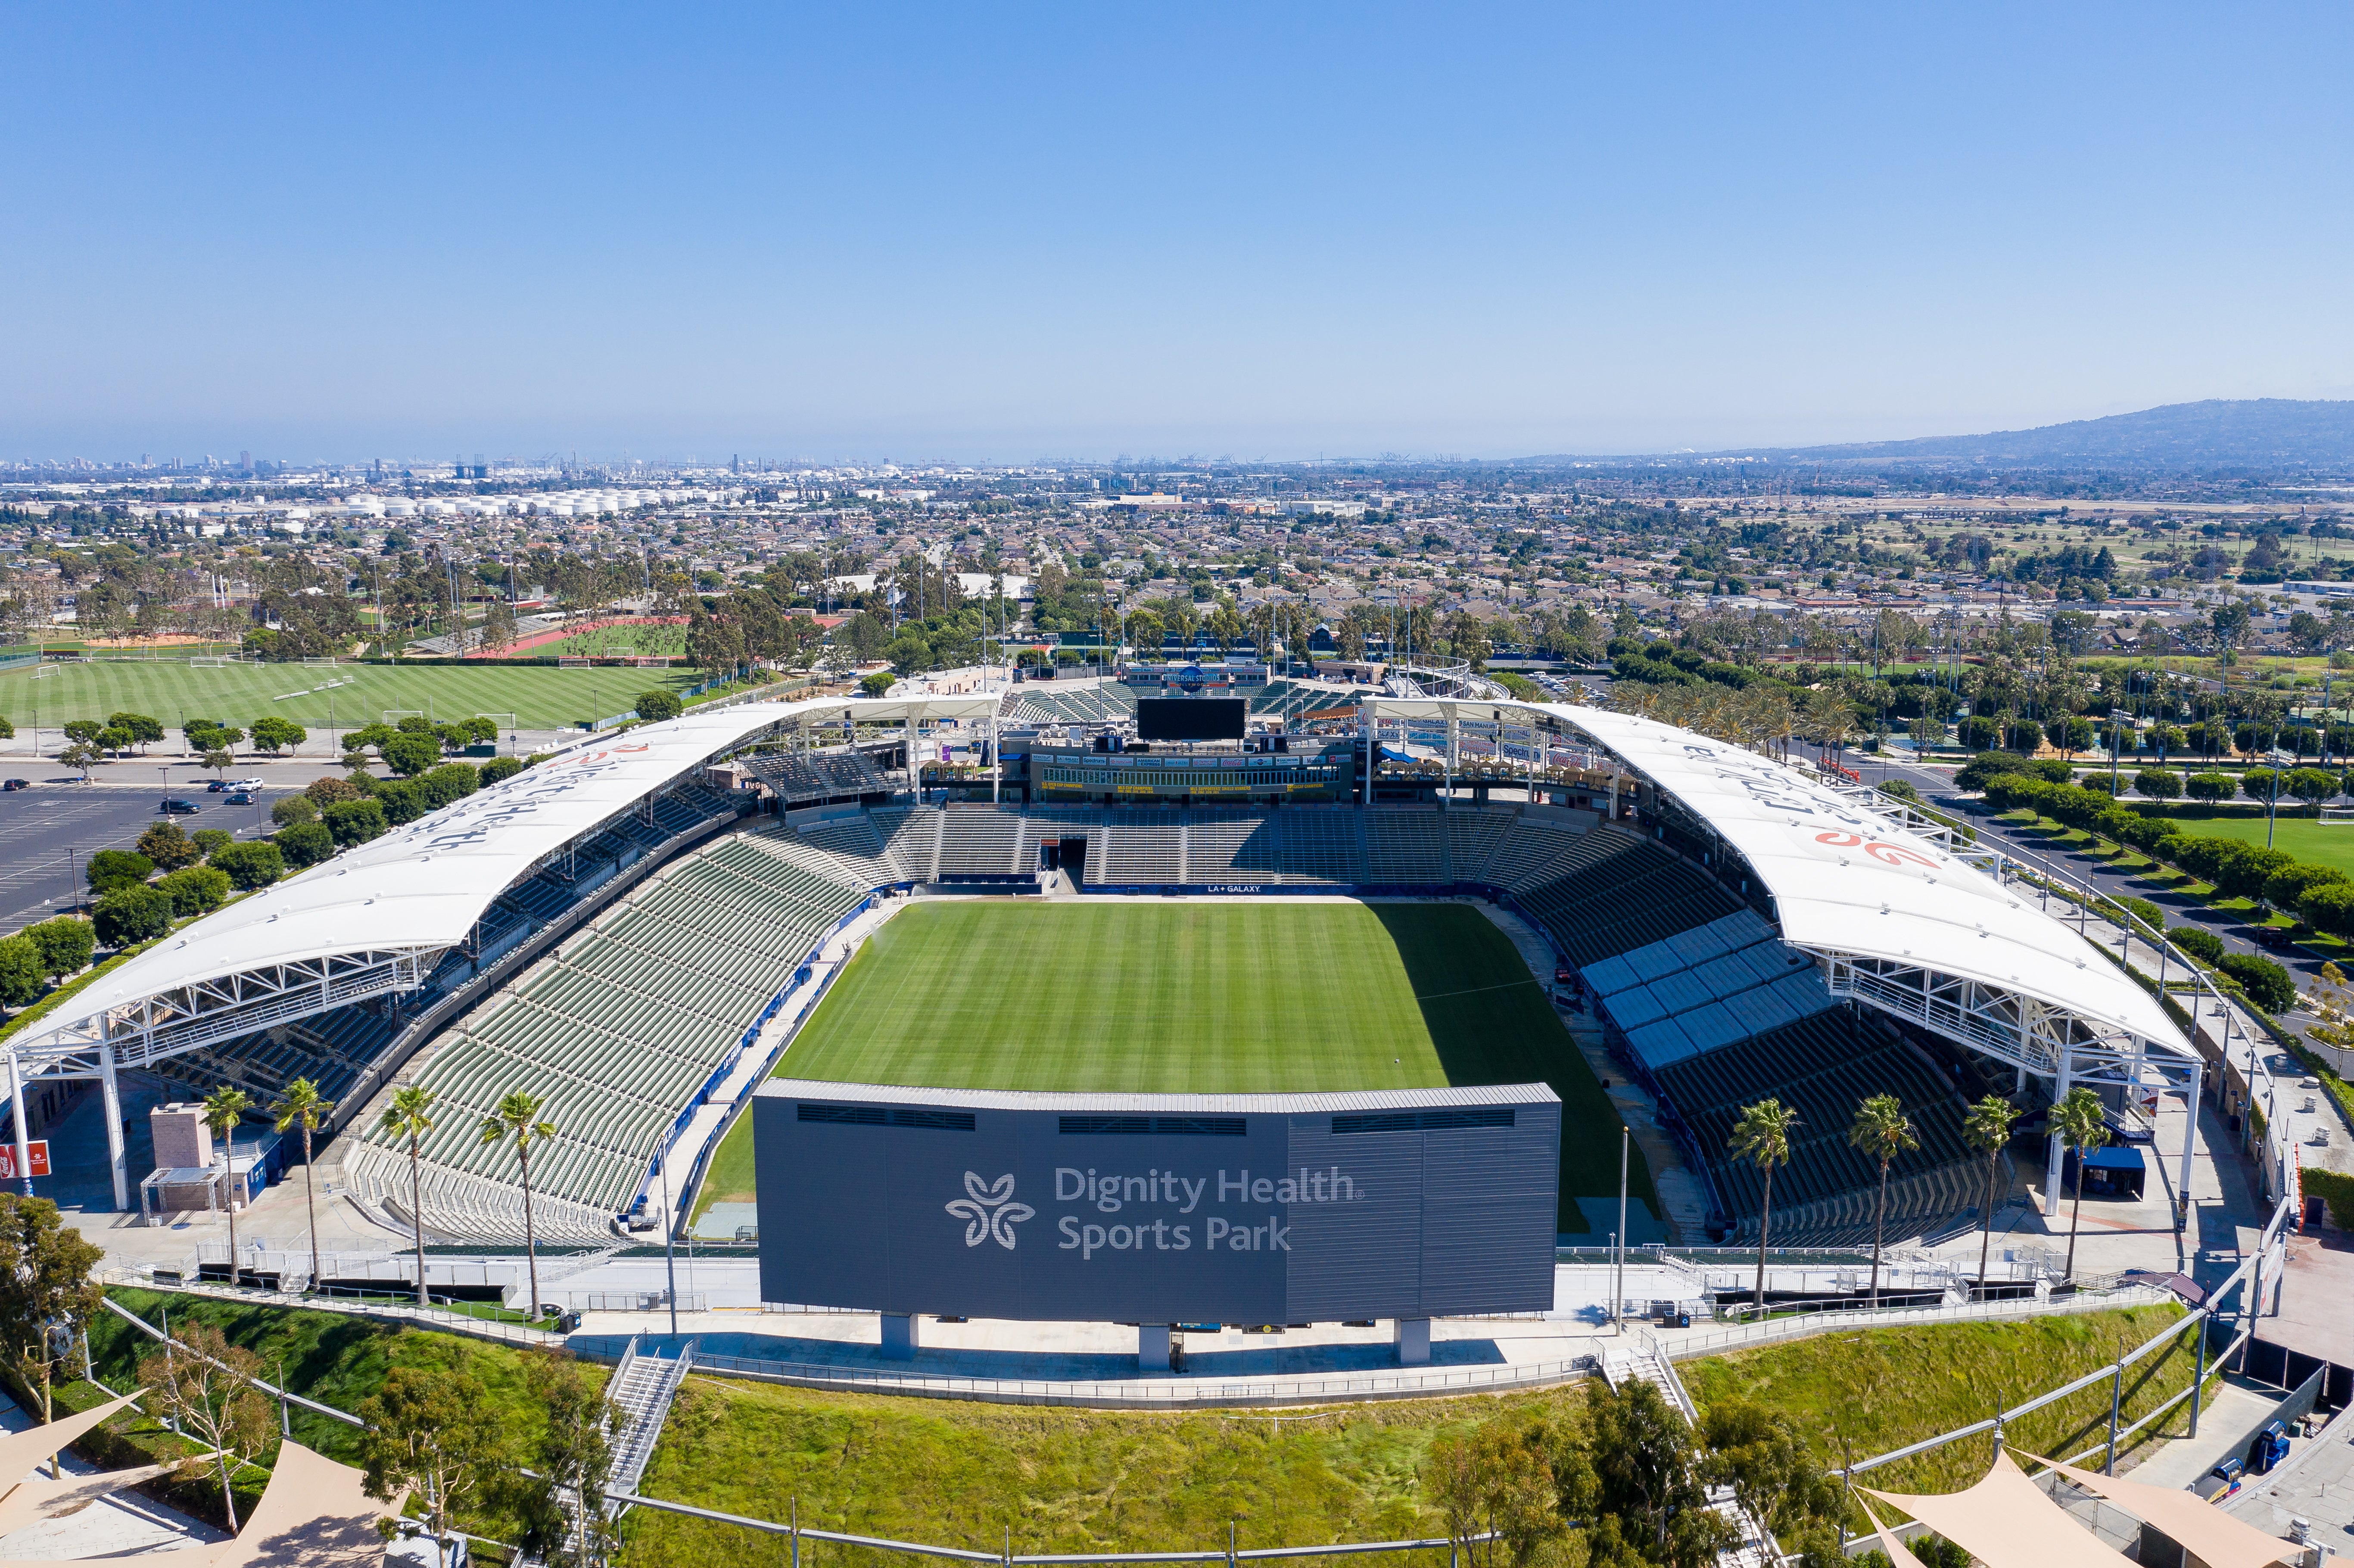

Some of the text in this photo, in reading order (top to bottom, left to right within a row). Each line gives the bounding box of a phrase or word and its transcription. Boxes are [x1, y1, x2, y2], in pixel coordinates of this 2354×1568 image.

[1518, 730, 1541, 738] GALXY
[1553, 753, 1582, 768] Coca-Cola
[780, 974, 796, 999] LA GALAXY
[724, 1040, 743, 1070] LA GALAXY
[1055, 1166, 1353, 1213] Dignity Health
[1058, 1216, 1292, 1260] Sports Park
